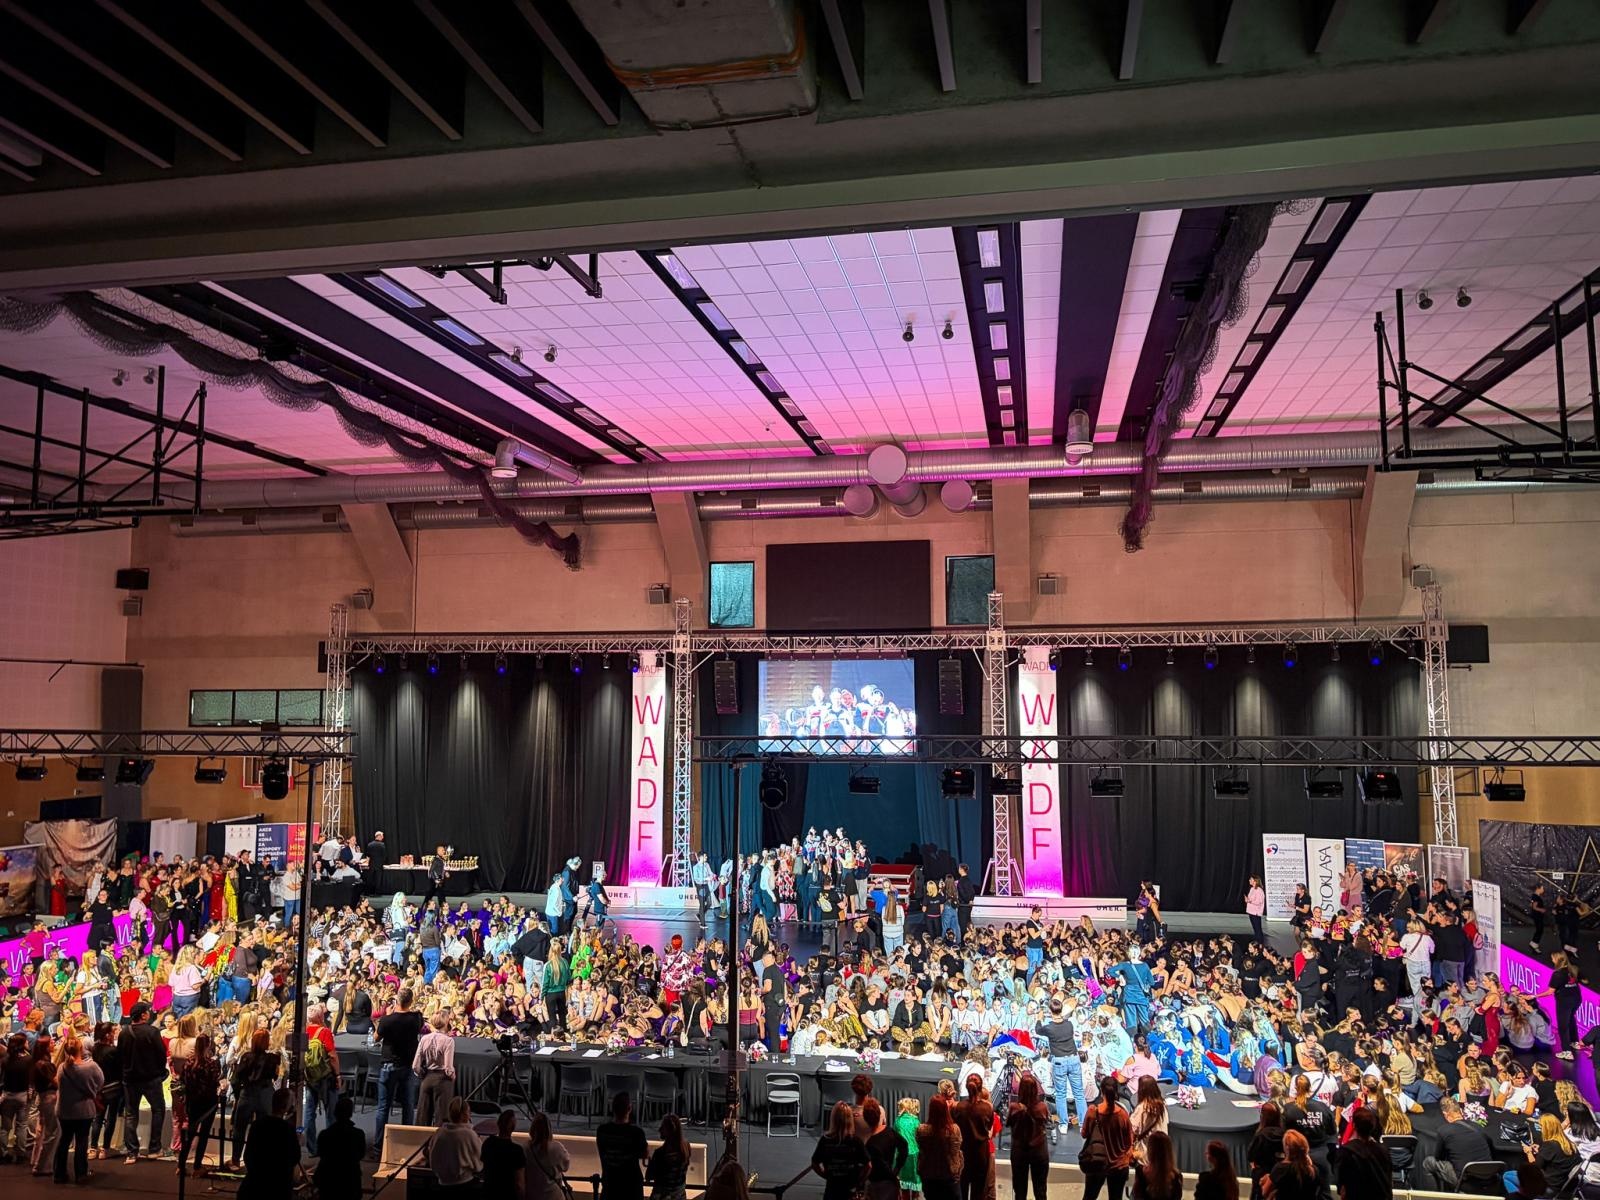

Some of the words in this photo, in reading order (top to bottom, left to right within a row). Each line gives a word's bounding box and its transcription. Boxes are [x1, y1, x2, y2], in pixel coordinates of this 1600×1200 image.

[634, 695, 664, 852] WADF
[1318, 846, 1334, 912] STOKLASA
[1506, 957, 1540, 996] WADF
